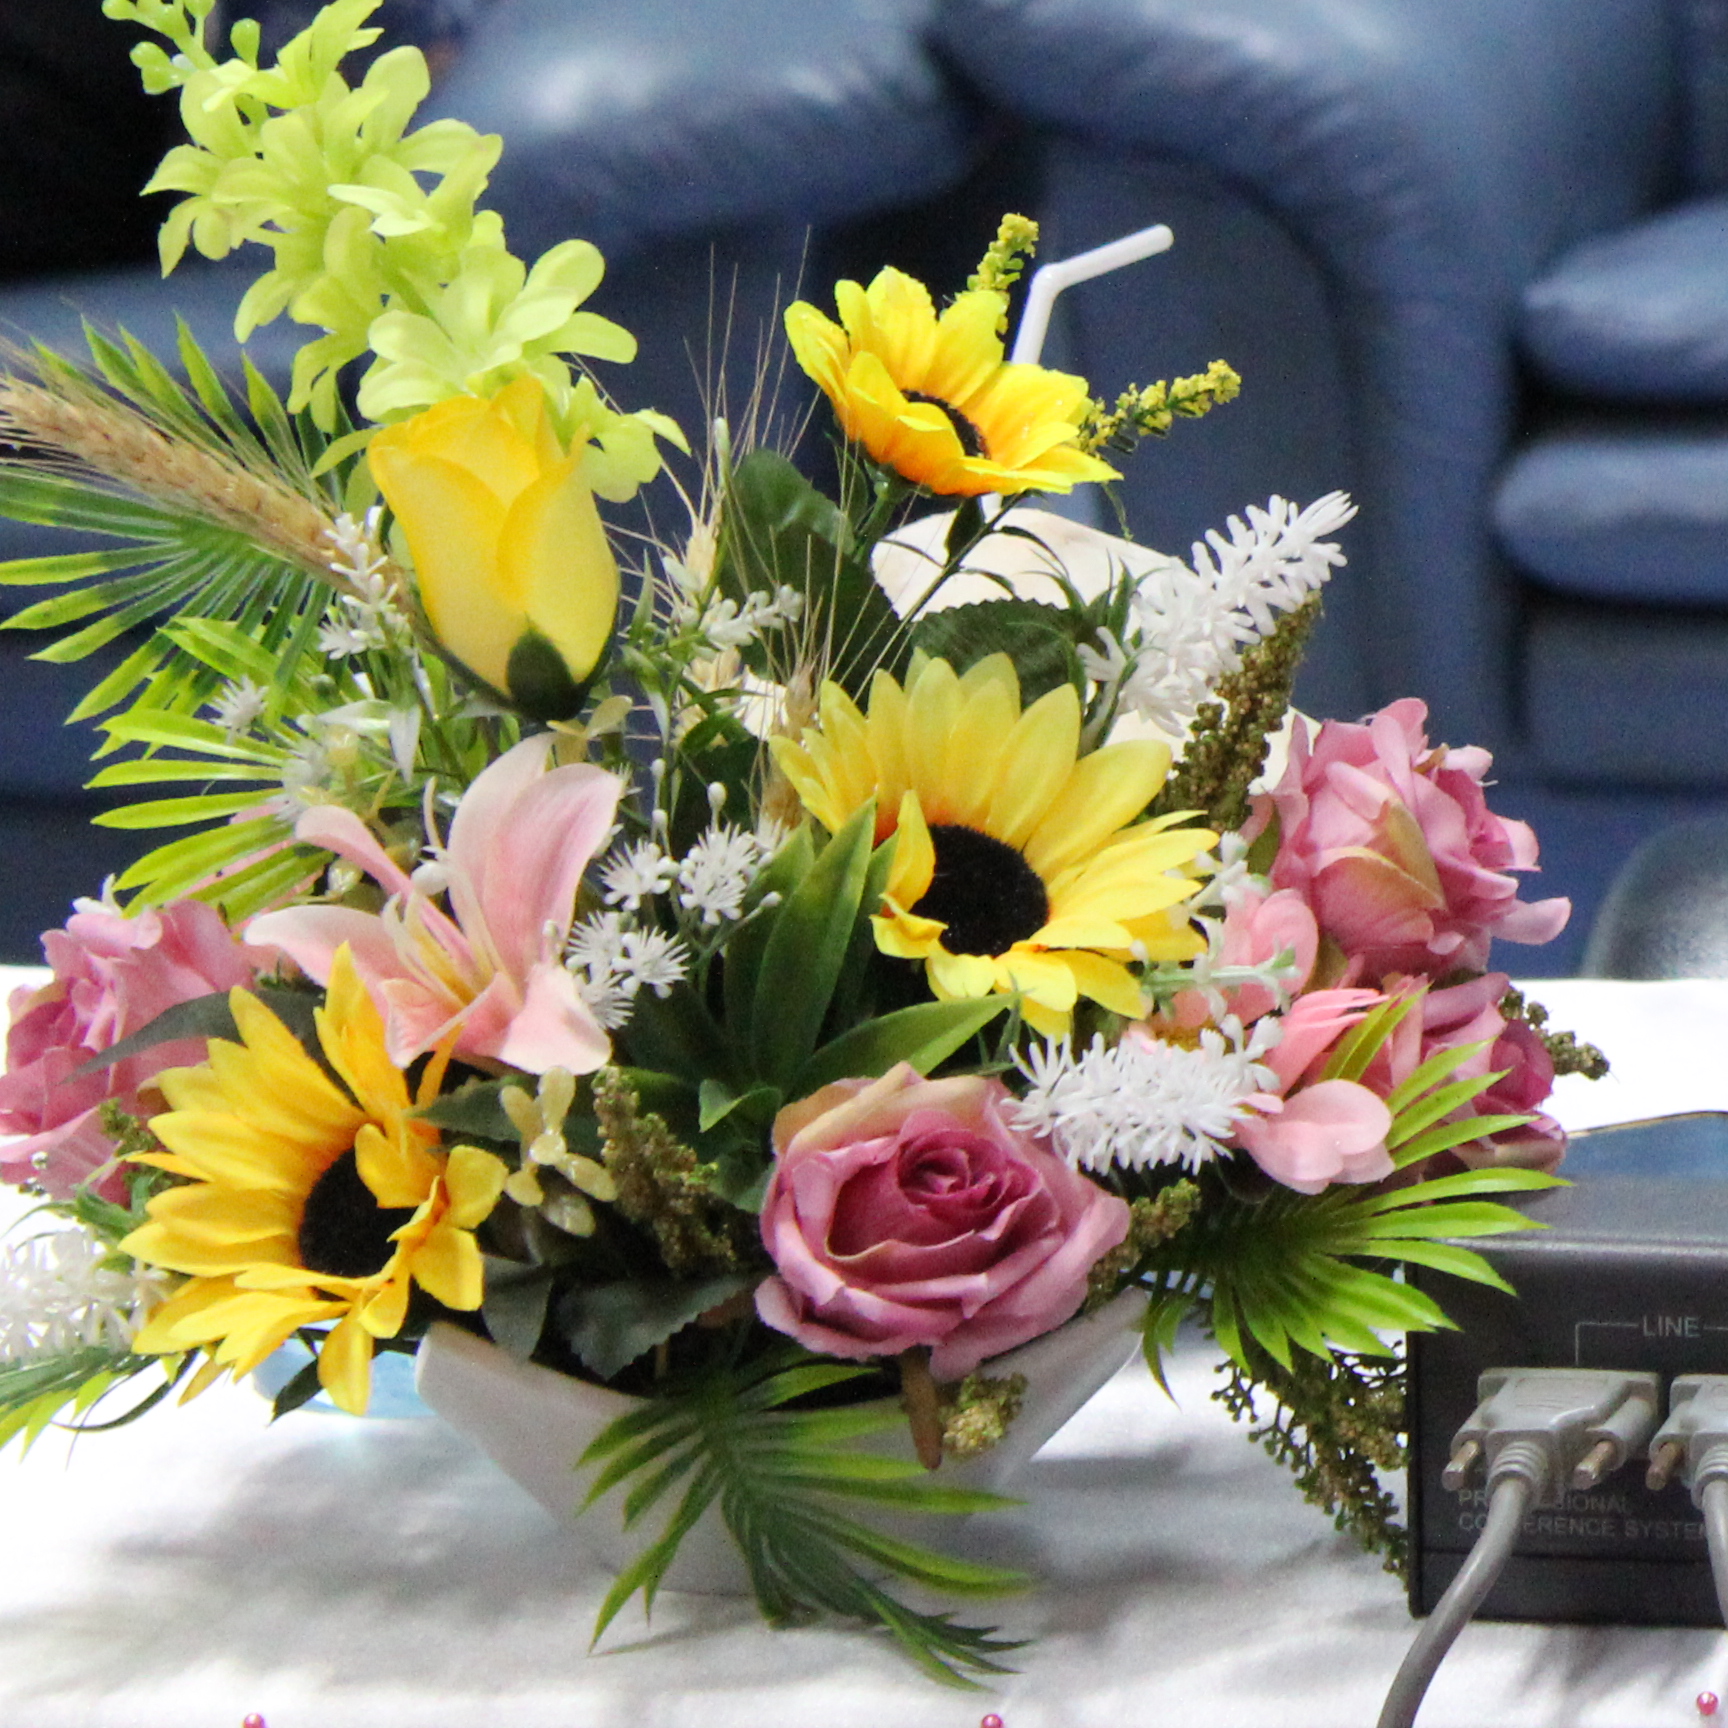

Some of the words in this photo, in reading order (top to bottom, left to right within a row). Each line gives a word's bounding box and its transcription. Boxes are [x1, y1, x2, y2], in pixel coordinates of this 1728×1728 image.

[1642, 1315, 1700, 1338] LINE
[1457, 1488, 1632, 1515] PRIONAL
[1457, 1511, 1616, 1539] COERENCE
